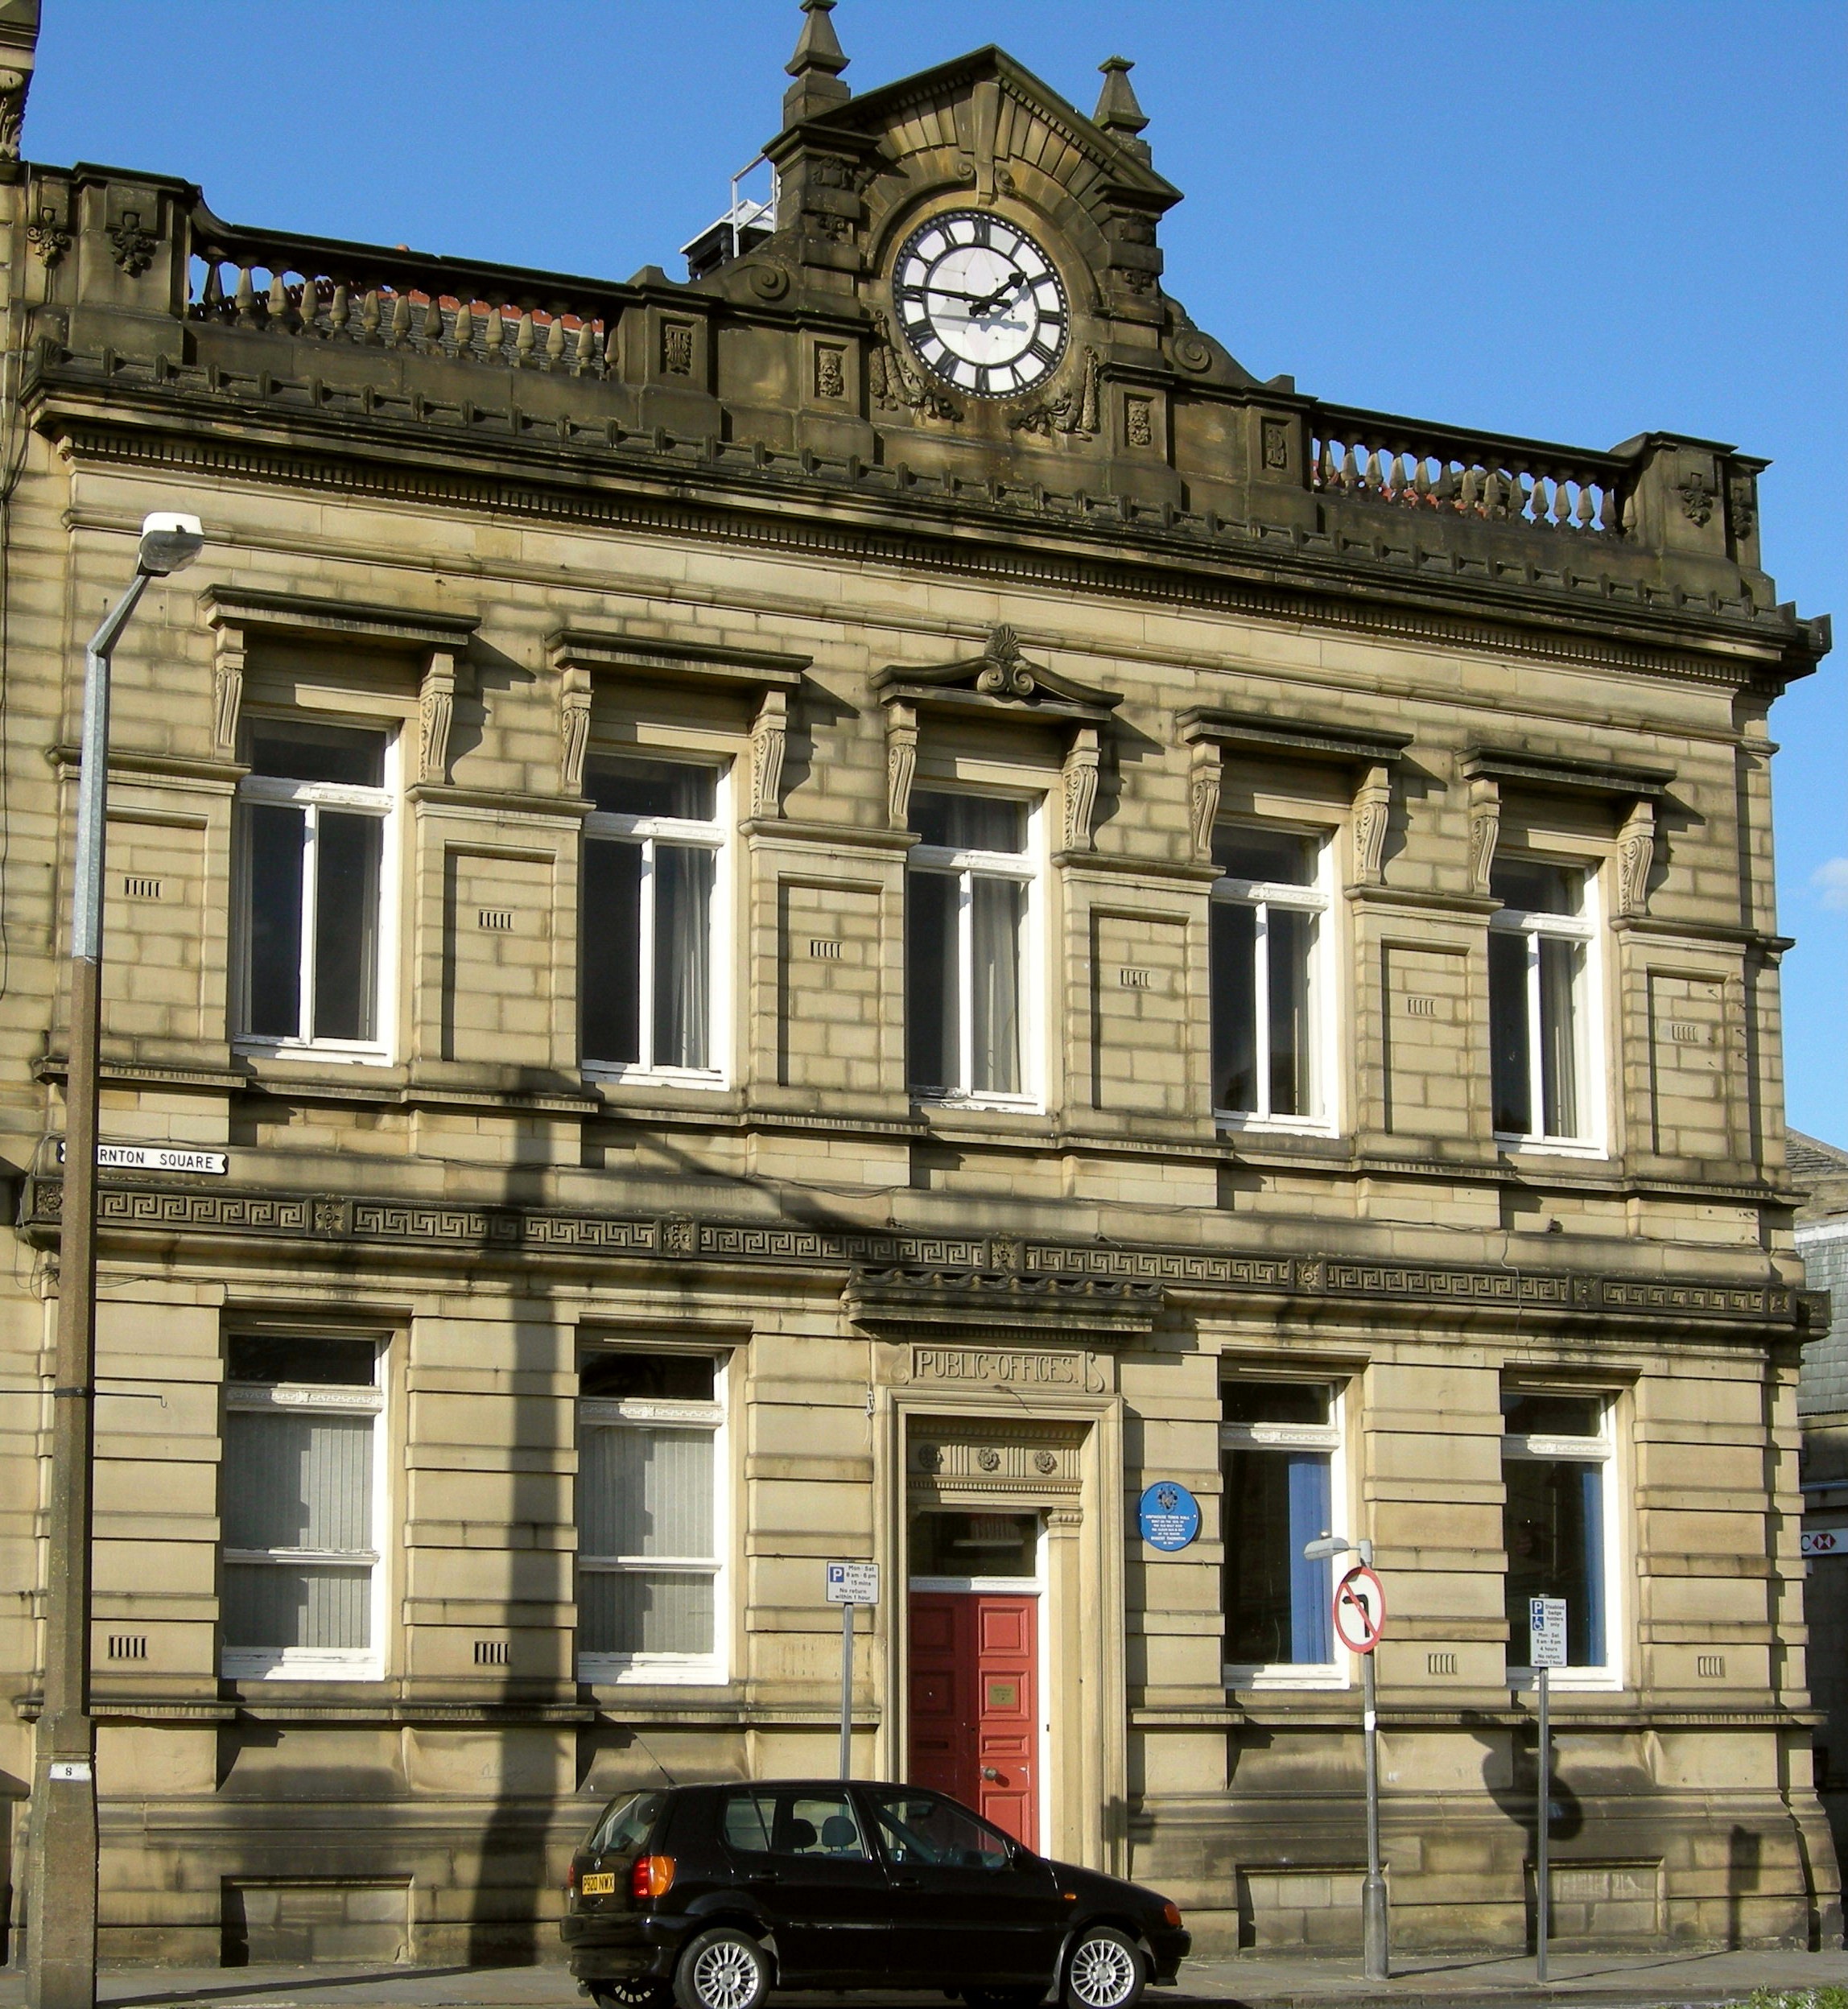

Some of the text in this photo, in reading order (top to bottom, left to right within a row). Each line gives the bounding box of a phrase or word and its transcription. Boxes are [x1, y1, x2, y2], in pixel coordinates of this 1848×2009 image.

[100, 1149, 214, 1170] RNTON SQUARE
[65, 1767, 72, 1776] 8
